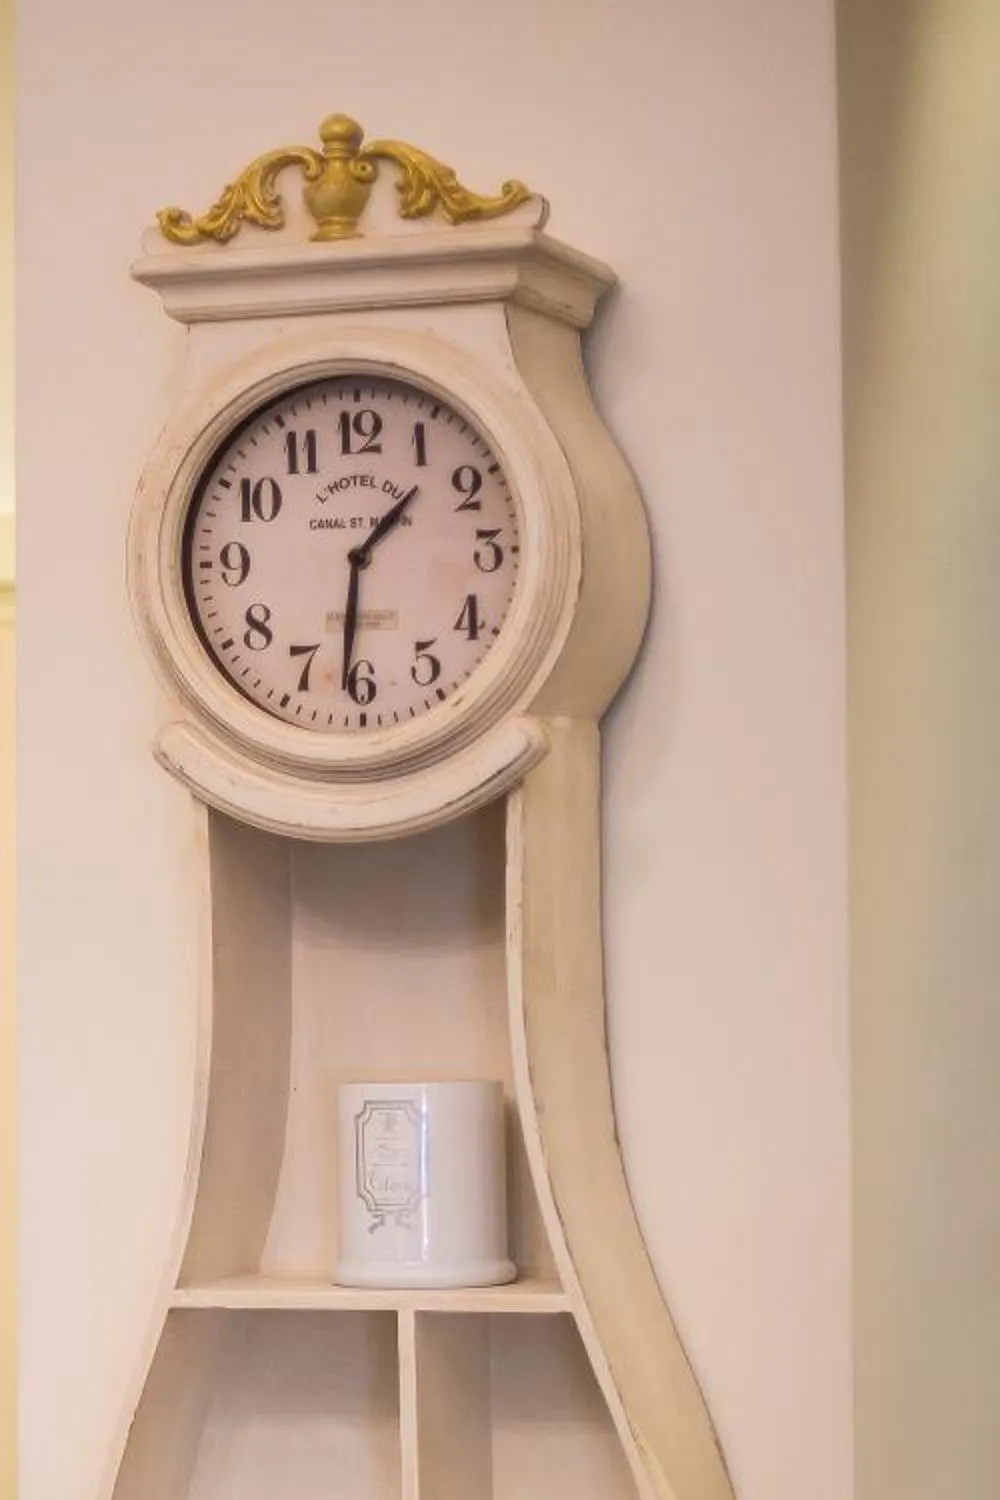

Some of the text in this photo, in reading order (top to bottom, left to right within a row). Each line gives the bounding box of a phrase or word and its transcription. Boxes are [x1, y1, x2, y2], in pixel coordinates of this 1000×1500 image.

[284, 429, 319, 475] 11
[339, 409, 383, 456] 12
[410, 421, 429, 467] 1
[239, 476, 283, 523] 10
[315, 475, 405, 504] L'HOTEL DU
[451, 464, 483, 513] 2
[309, 517, 347, 530] CANAL
[219, 541, 251, 587] 9
[473, 528, 503, 573] 3
[243, 603, 273, 651] 8
[452, 593, 486, 641] 4
[288, 643, 321, 692] 7
[347, 659, 378, 706] 6
[410, 637, 442, 687] 5
